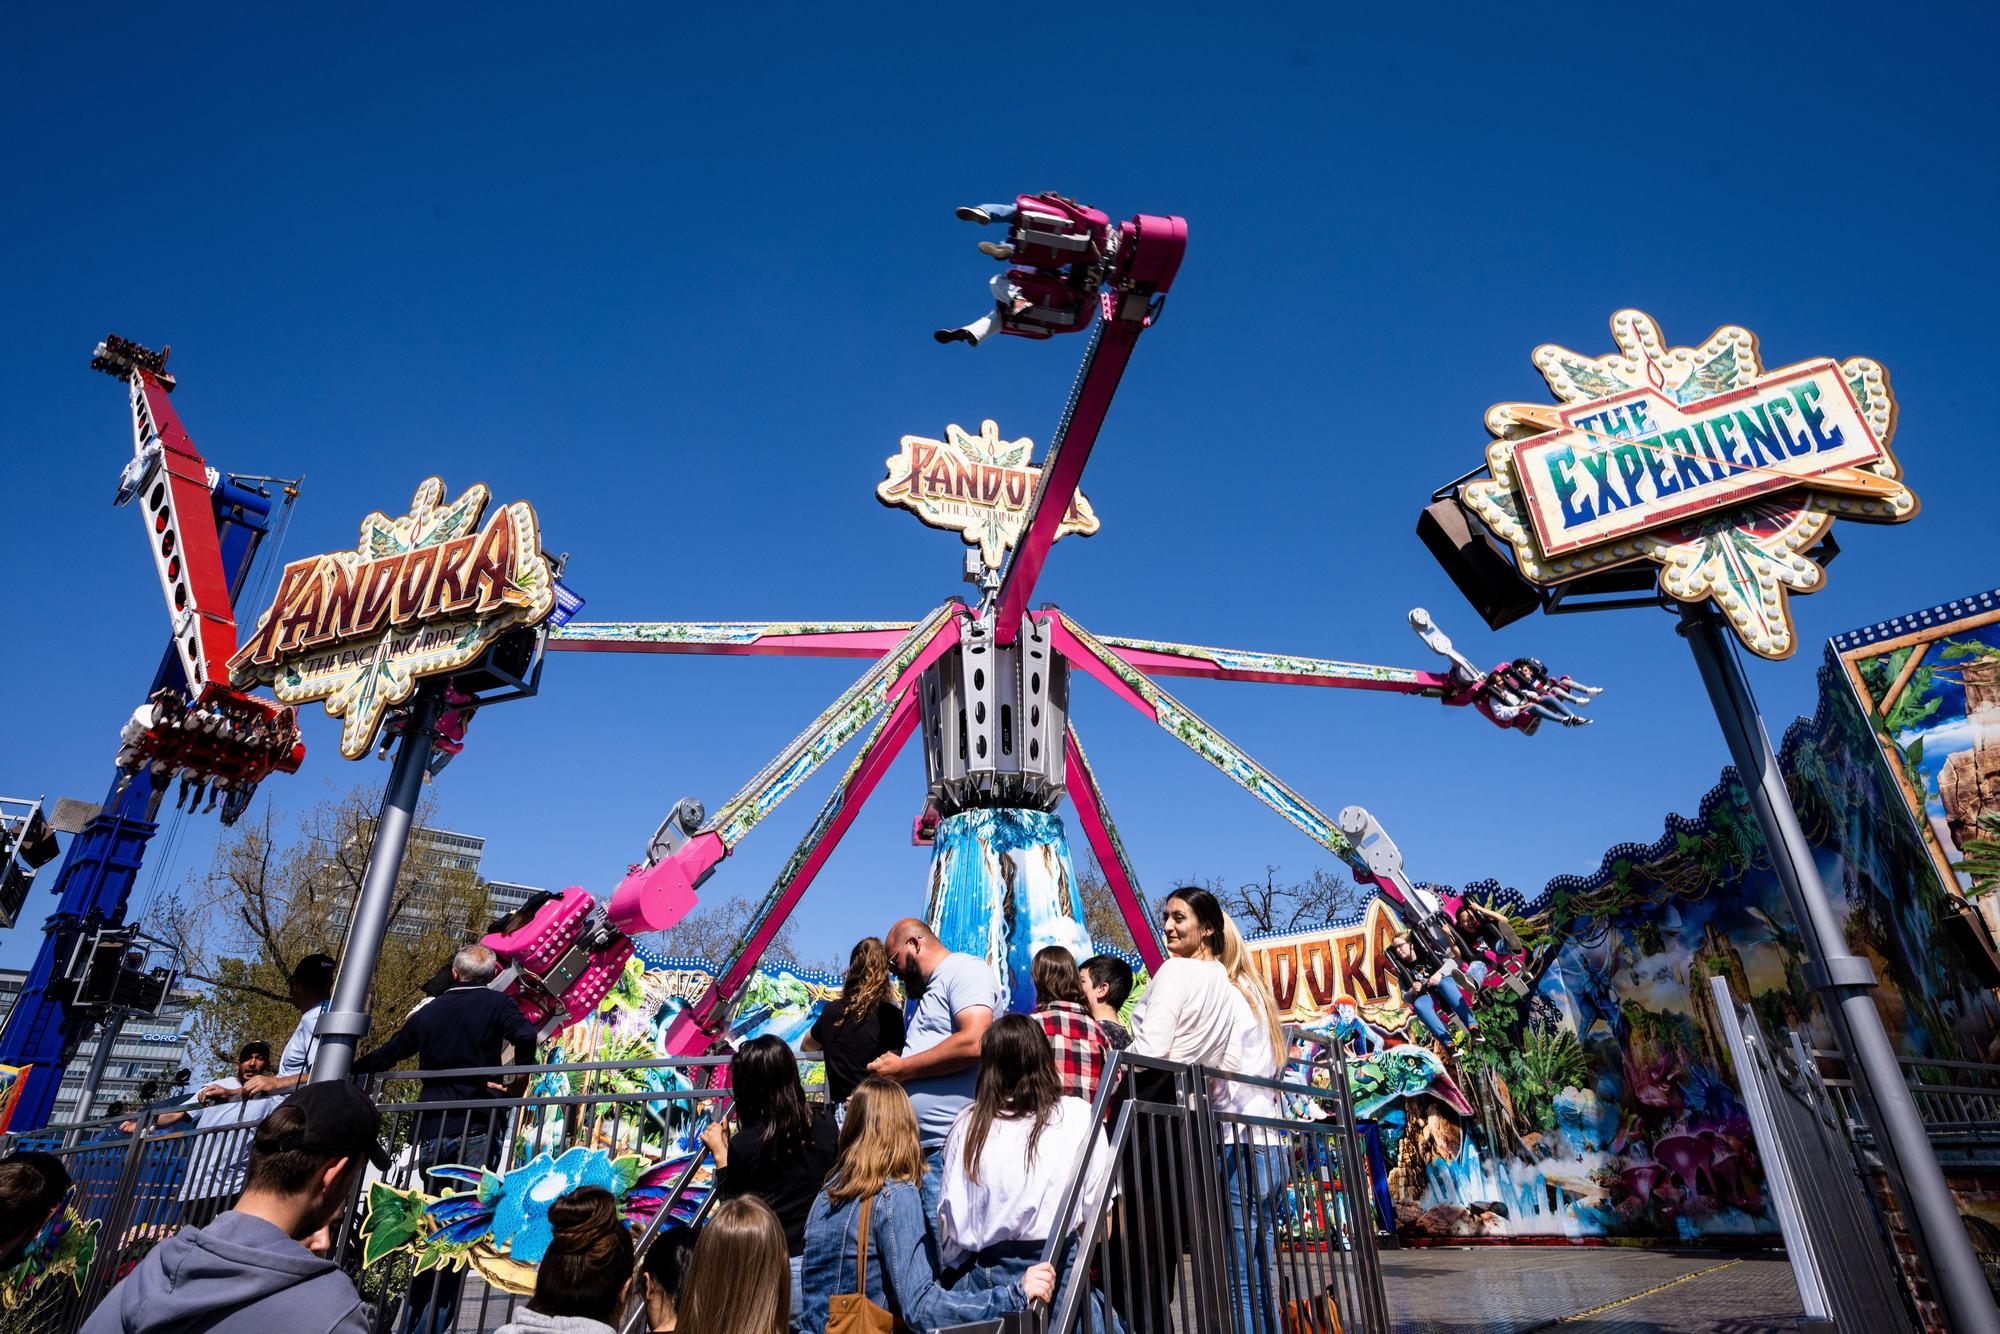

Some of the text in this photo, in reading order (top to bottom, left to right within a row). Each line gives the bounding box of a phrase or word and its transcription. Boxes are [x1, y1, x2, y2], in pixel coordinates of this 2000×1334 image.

[1545, 380, 1846, 529] EXPERIENCE
[1573, 400, 1658, 445] THE
[887, 441, 1093, 526] PANDO
[226, 503, 535, 669] PANDORA
[306, 625, 464, 678] THE EXCITING RIDE
[1251, 905, 1402, 1011] DORA
